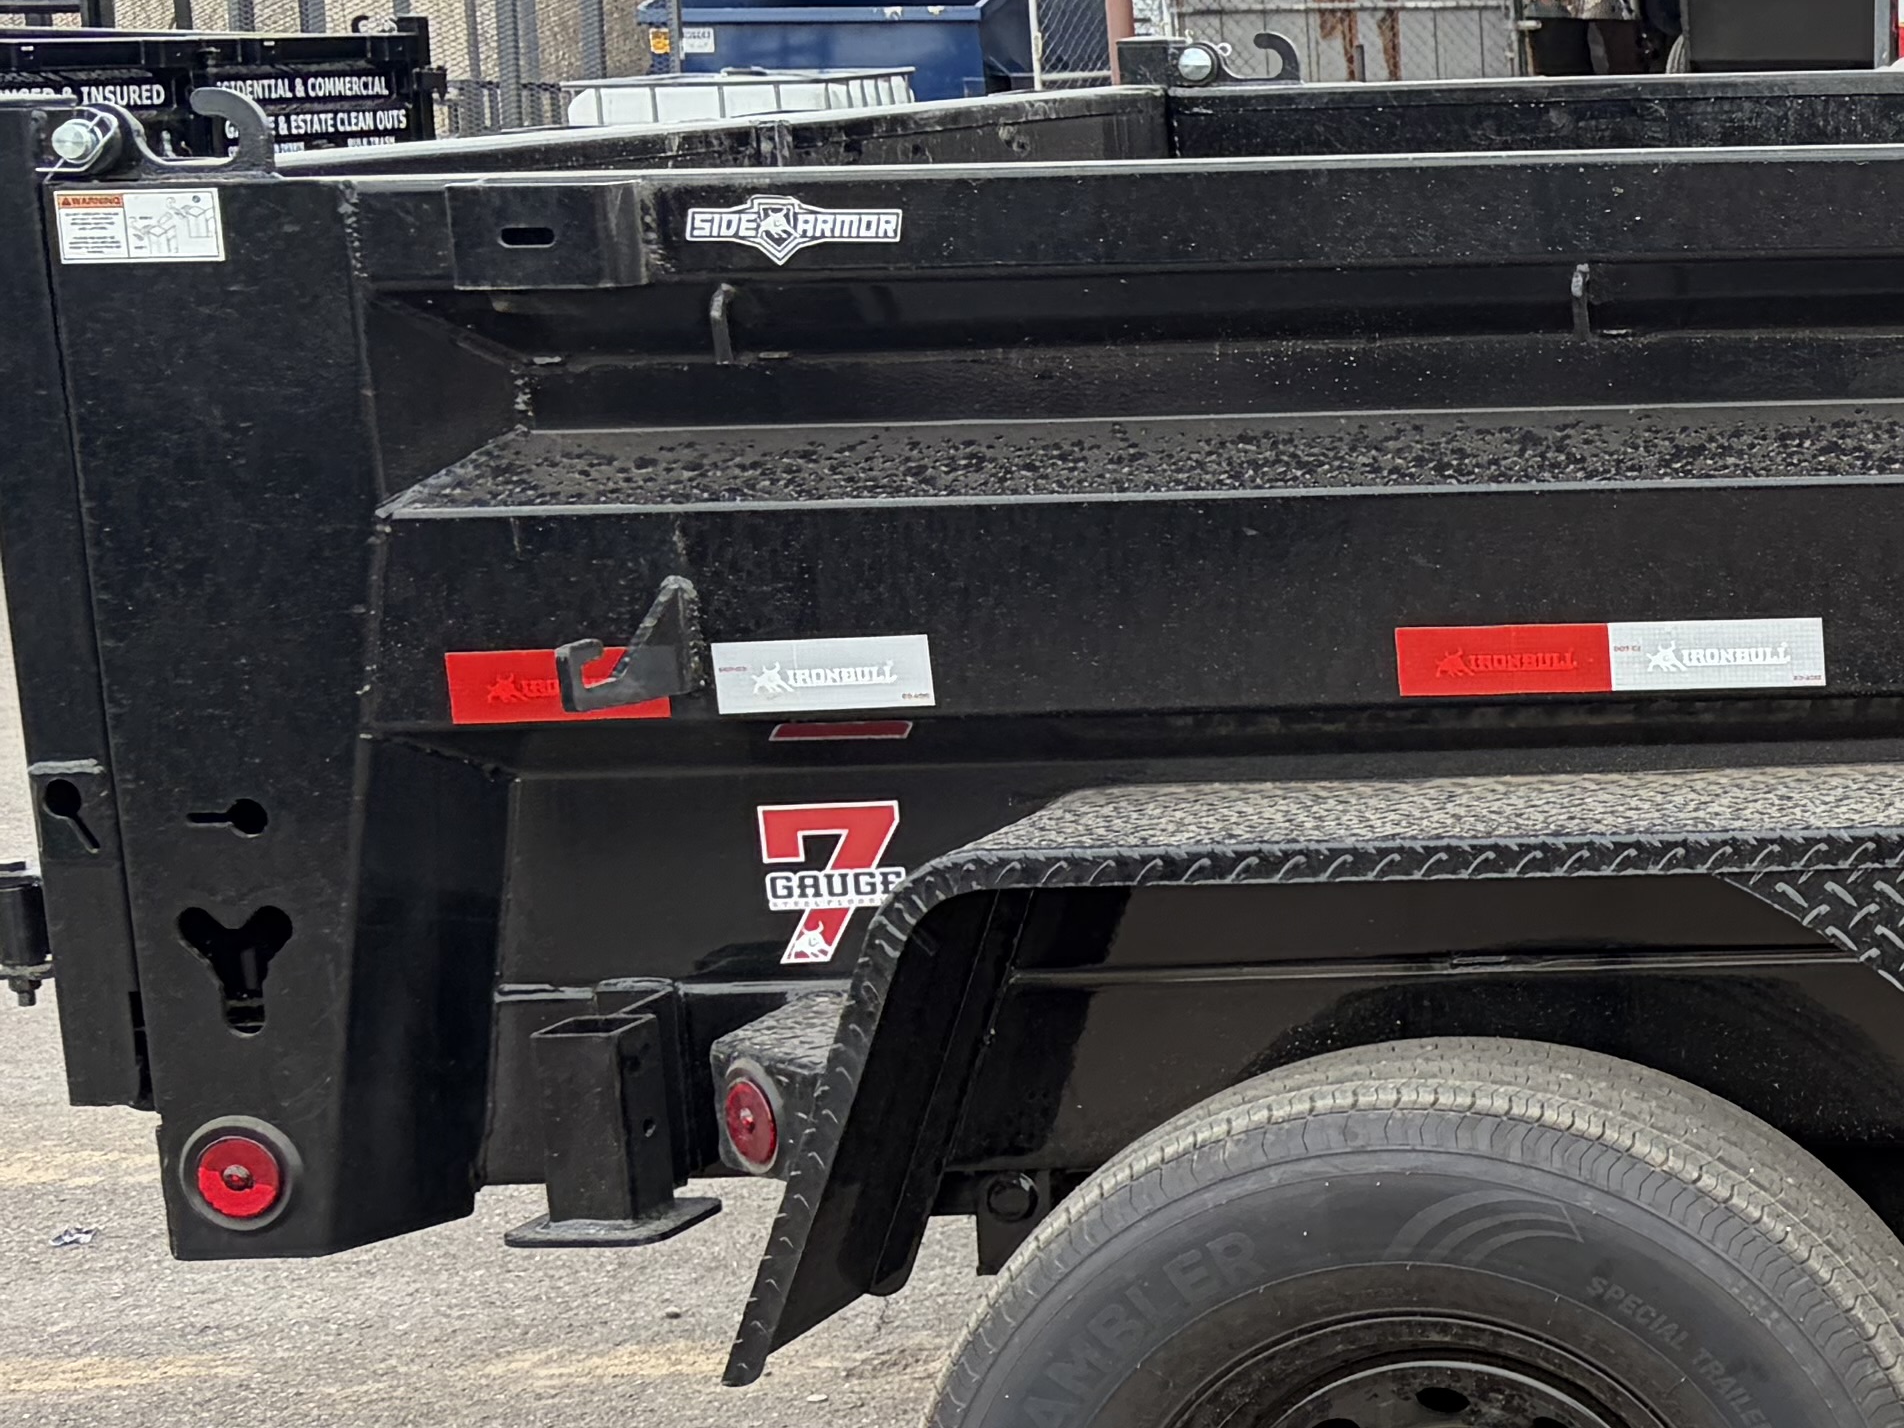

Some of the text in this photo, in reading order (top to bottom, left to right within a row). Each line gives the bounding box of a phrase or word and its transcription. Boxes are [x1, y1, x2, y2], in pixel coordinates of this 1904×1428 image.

[81, 83, 165, 106] INSURED
[295, 78, 305, 98] &
[307, 75, 389, 97] COMMERCIAL
[278, 117, 289, 136] &
[291, 114, 335, 135] ESTATE
[337, 111, 375, 133] CLEAN
[376, 109, 407, 130] OUTS
[72, 195, 121, 206] WARNING
[693, 214, 897, 239] SIDE ARMOR
[1470, 651, 1575, 671] IRONBULL
[1681, 645, 1791, 667] IRONBULL
[787, 664, 897, 687] IRONBULL
[757, 800, 900, 964] 7
[769, 872, 903, 900] GAUGE
[1586, 1275, 1689, 1352] SPECIAL
